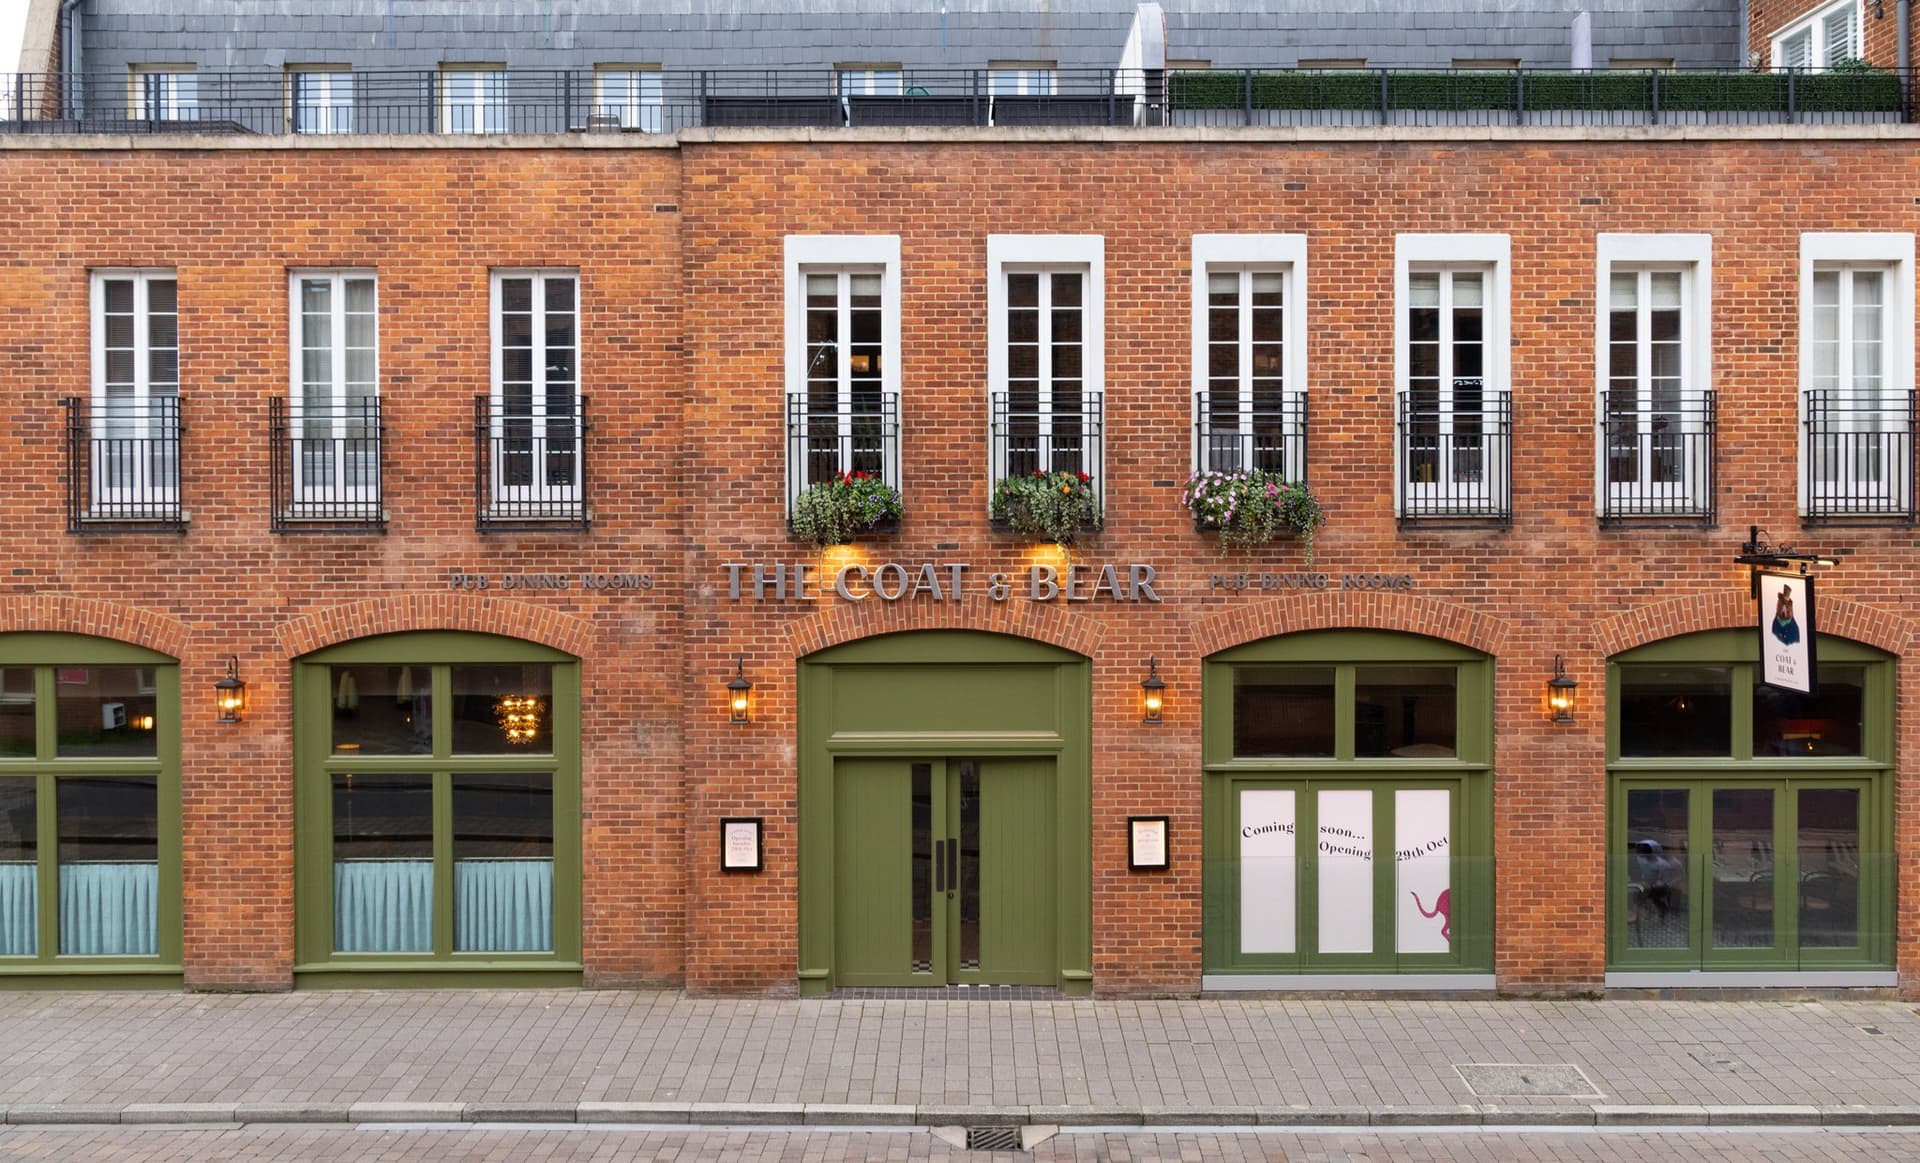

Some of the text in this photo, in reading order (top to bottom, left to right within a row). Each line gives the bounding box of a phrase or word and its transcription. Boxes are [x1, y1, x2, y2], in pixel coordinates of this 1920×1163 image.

[451, 574, 653, 590] PUB DINING ROOMS
[721, 563, 1161, 601] THE COAT & BEAR
[1210, 574, 1413, 590] PUB DINING ROOMS
[1776, 654, 1792, 665] COAT
[1778, 665, 1794, 676] BEAR
[1242, 821, 1294, 838] Coming
[1319, 836, 1449, 861] Opening 29th Oct
